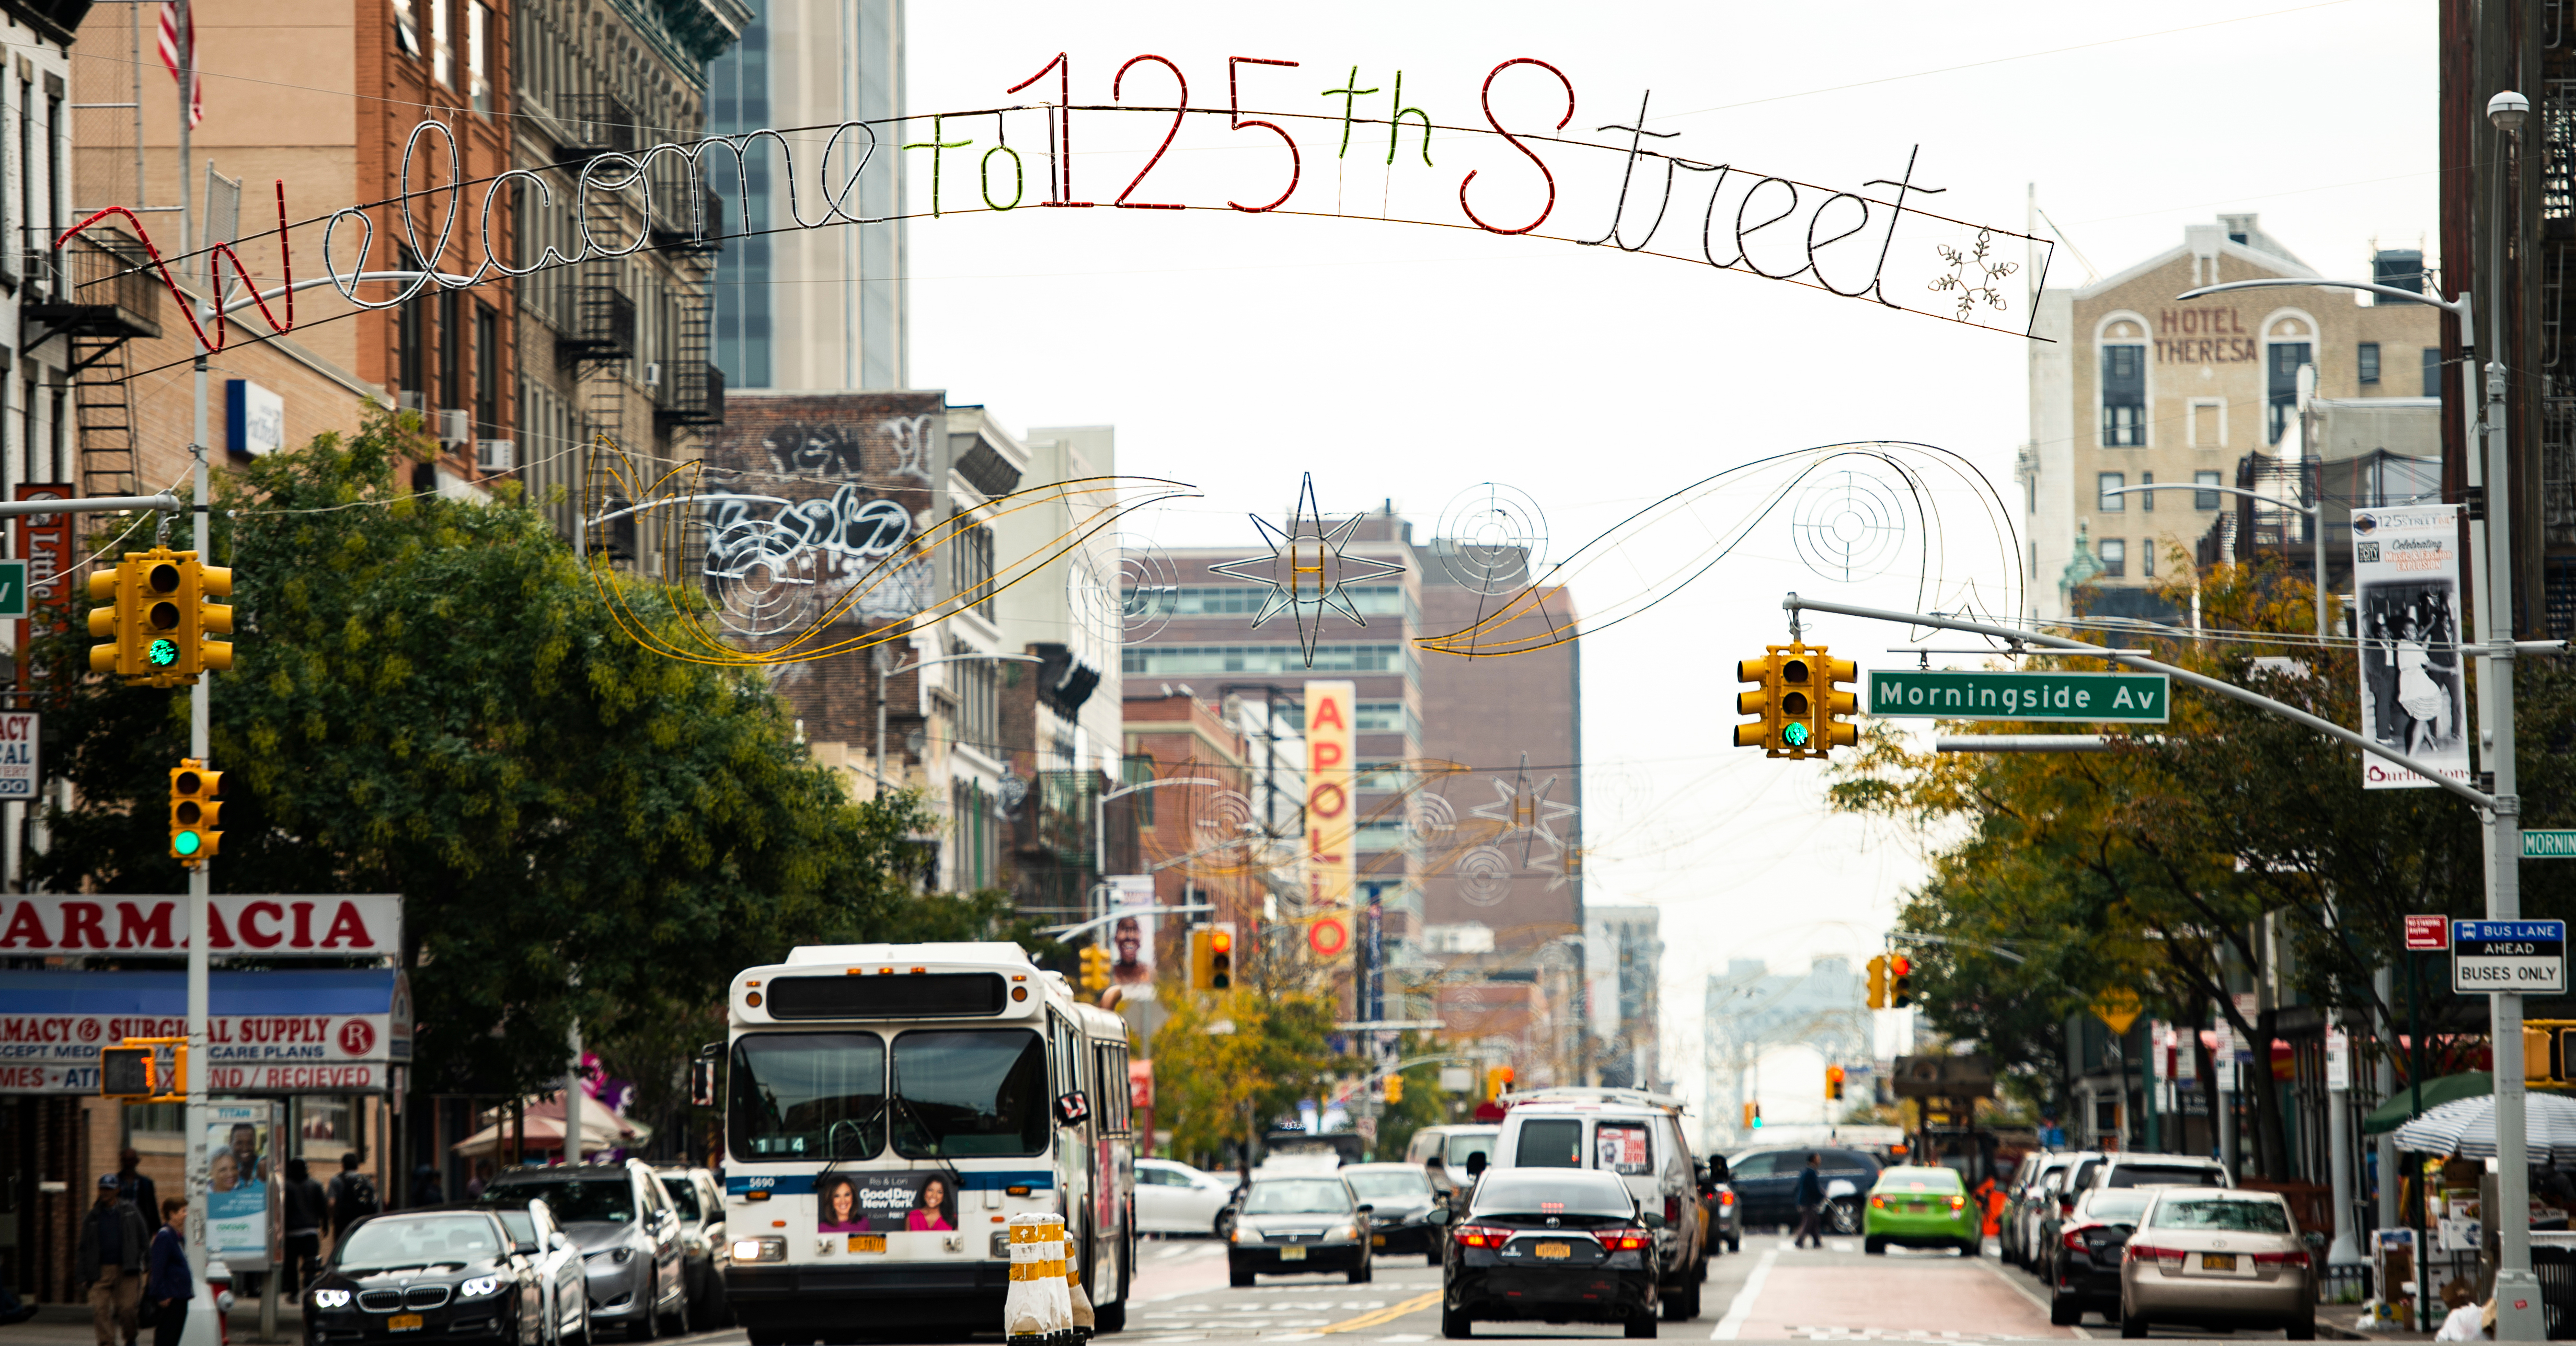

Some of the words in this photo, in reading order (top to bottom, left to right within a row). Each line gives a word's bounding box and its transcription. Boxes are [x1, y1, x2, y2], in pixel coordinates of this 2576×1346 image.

[55, 119, 883, 354] Welcome
[902, 114, 1023, 218] to
[1460, 57, 1947, 309] Street
[2161, 307, 2246, 333] HOTEL
[2154, 337, 2258, 363] THERESA
[2393, 538, 2442, 552] Celebrating
[2363, 549, 2378, 558] CITY
[2385, 551, 2411, 562] Music
[2412, 550, 2420, 561] &
[2421, 549, 2452, 561] Fashion
[29, 531, 61, 600] Little
[2397, 560, 2442, 572] EXPLOSION
[1881, 682, 2090, 714] Morningside
[2112, 685, 2155, 710] Av
[0, 743, 31, 764] AL
[1309, 698, 1348, 956] APOLLO
[2525, 833, 2576, 855] MORNIN
[0, 900, 375, 948] ARMACIA
[2483, 925, 2512, 937] BUS
[2516, 925, 2556, 937] LANE
[2483, 942, 2535, 954] AHEAD
[2462, 966, 2511, 981] BUSES
[2518, 966, 2557, 981] ONLY
[0, 1017, 73, 1042] MACY
[239, 1018, 331, 1043] SUPPLY
[0, 1044, 49, 1057] CEPT
[264, 1045, 325, 1059] PLANS
[64, 1068, 101, 1087] AT
[266, 1066, 371, 1088] RECIEVED
[218, 1108, 251, 1118] TITAN
[749, 1177, 775, 1188] 5690
[869, 1177, 882, 1186] Ro
[883, 1177, 890, 1186] &
[859, 1187, 893, 1200] Good
[893, 1187, 917, 1202] Day
[862, 1199, 889, 1209] New
[889, 1198, 913, 1209] York
